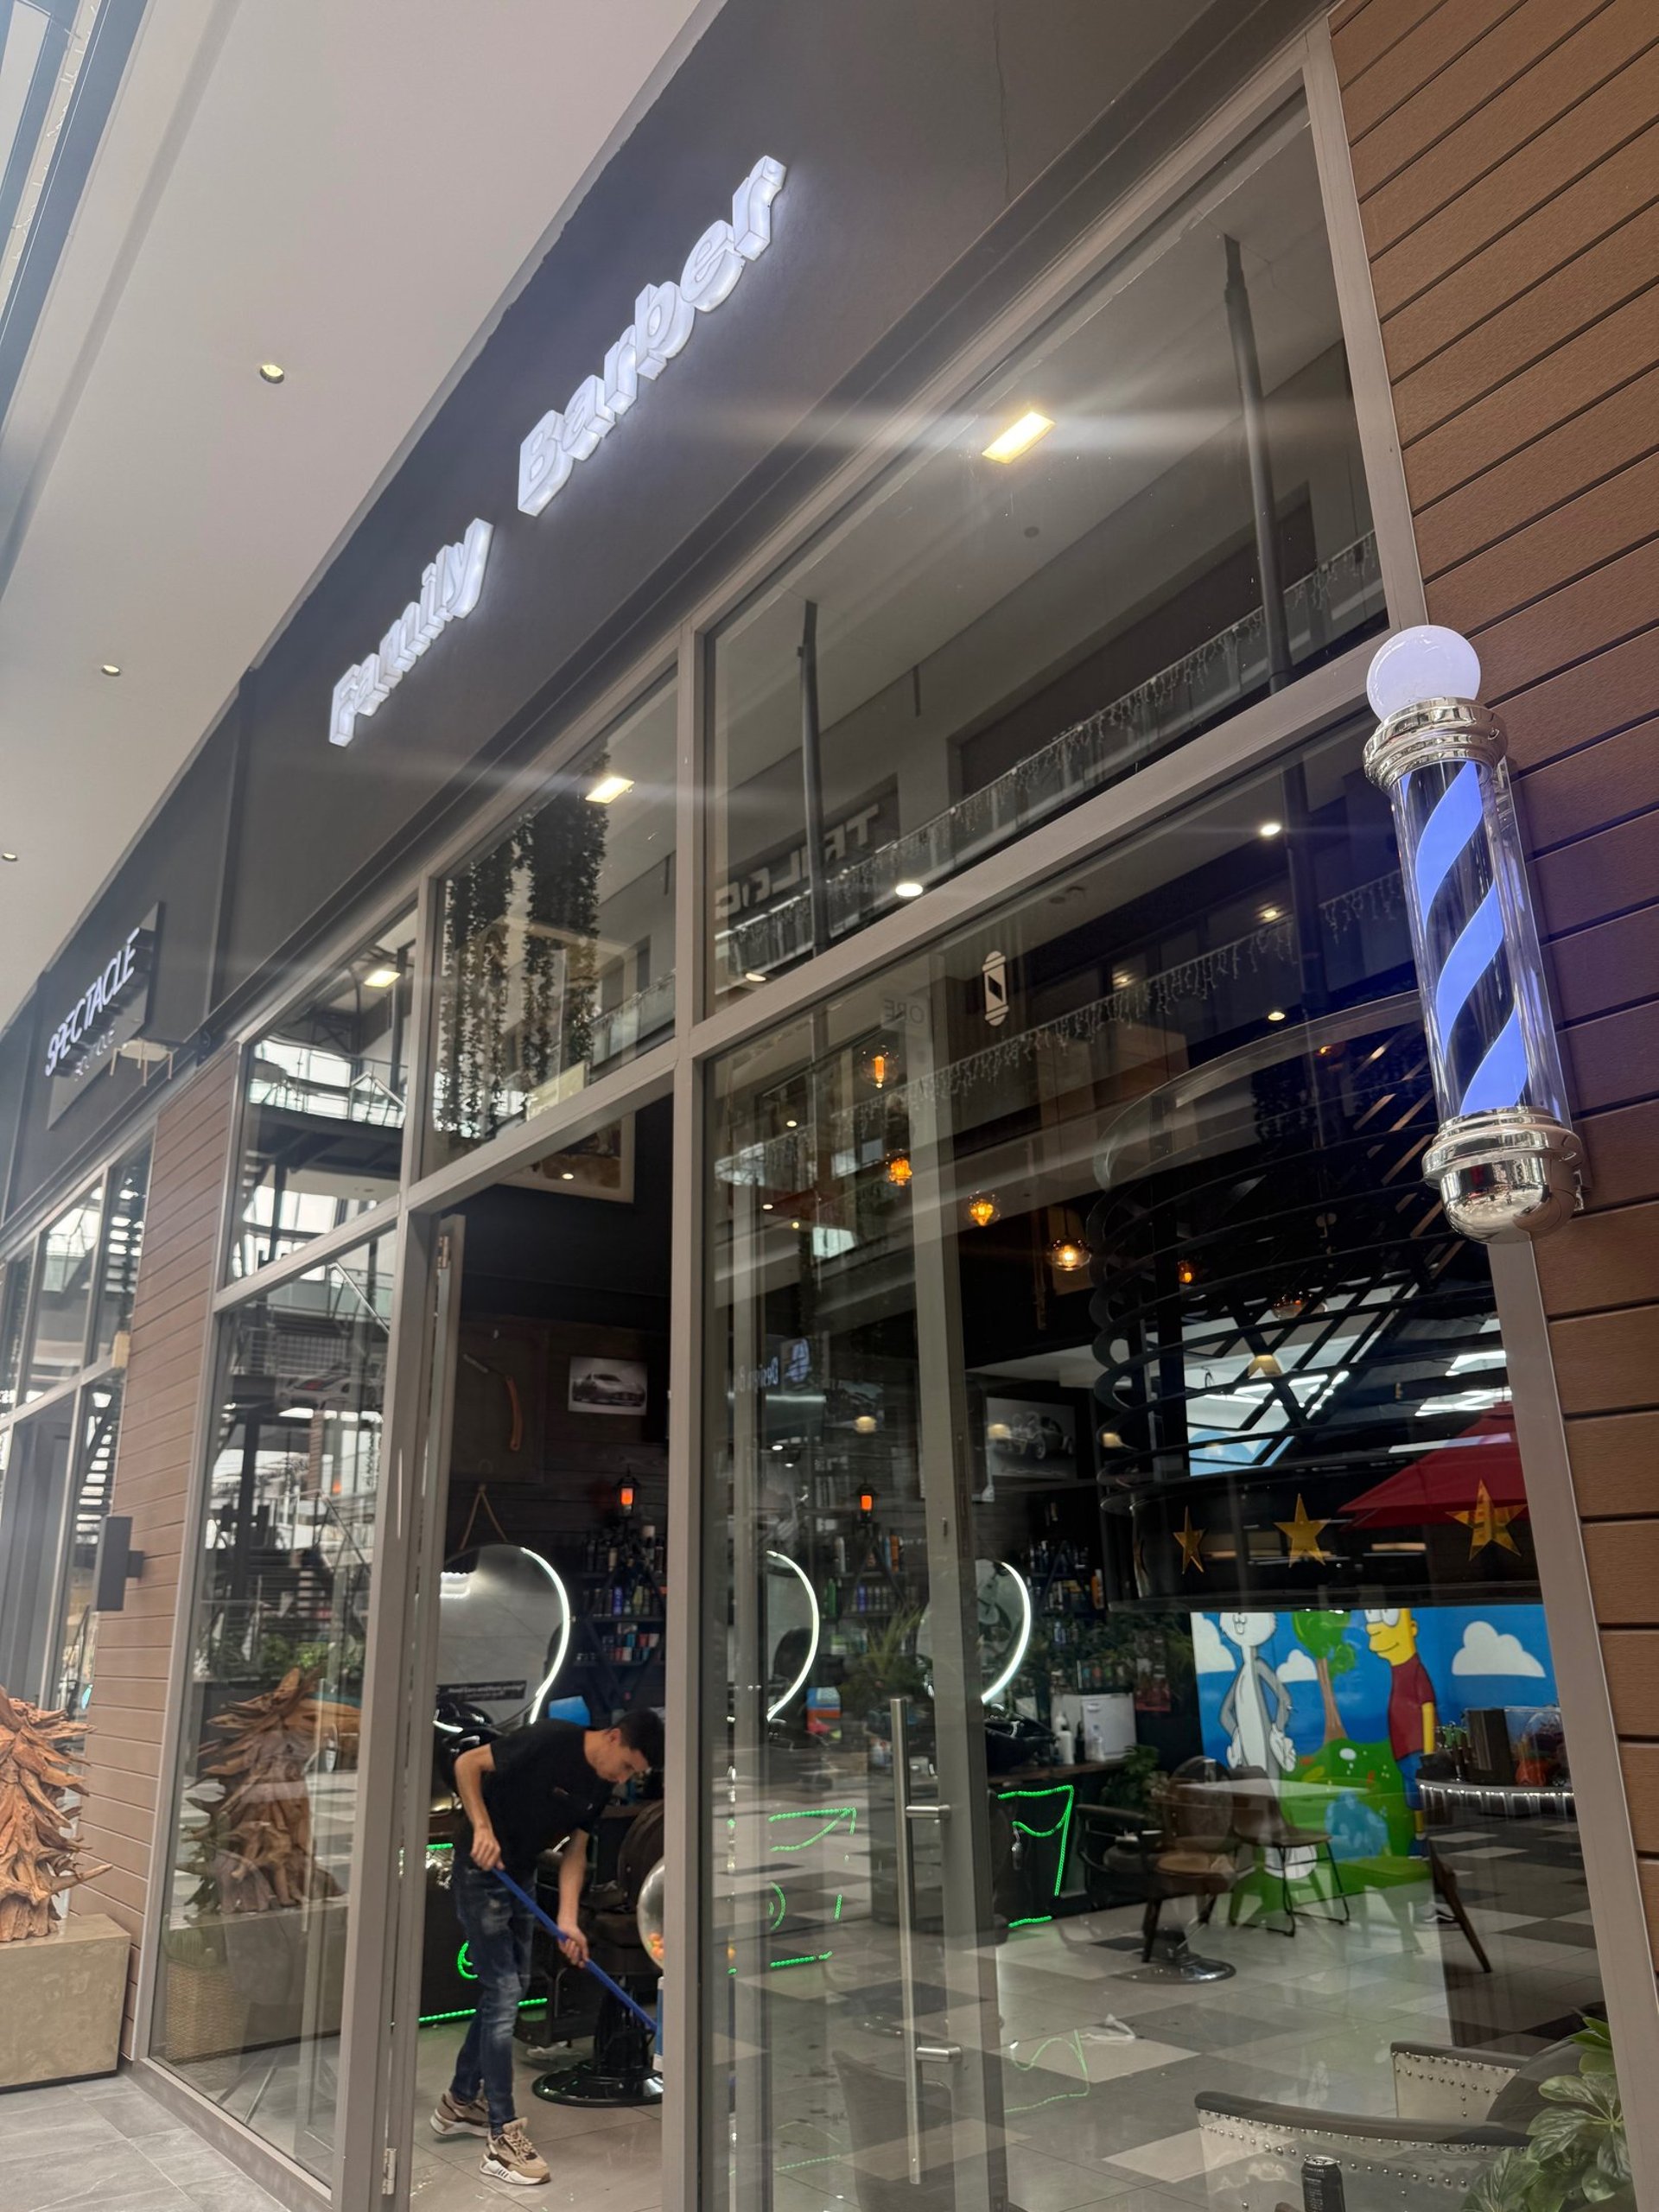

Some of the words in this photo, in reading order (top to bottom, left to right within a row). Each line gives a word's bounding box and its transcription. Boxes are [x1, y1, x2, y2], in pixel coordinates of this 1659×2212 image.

[328, 517, 494, 747] Family
[517, 155, 787, 517] Barber
[45, 926, 140, 1077] SPECTACLE
